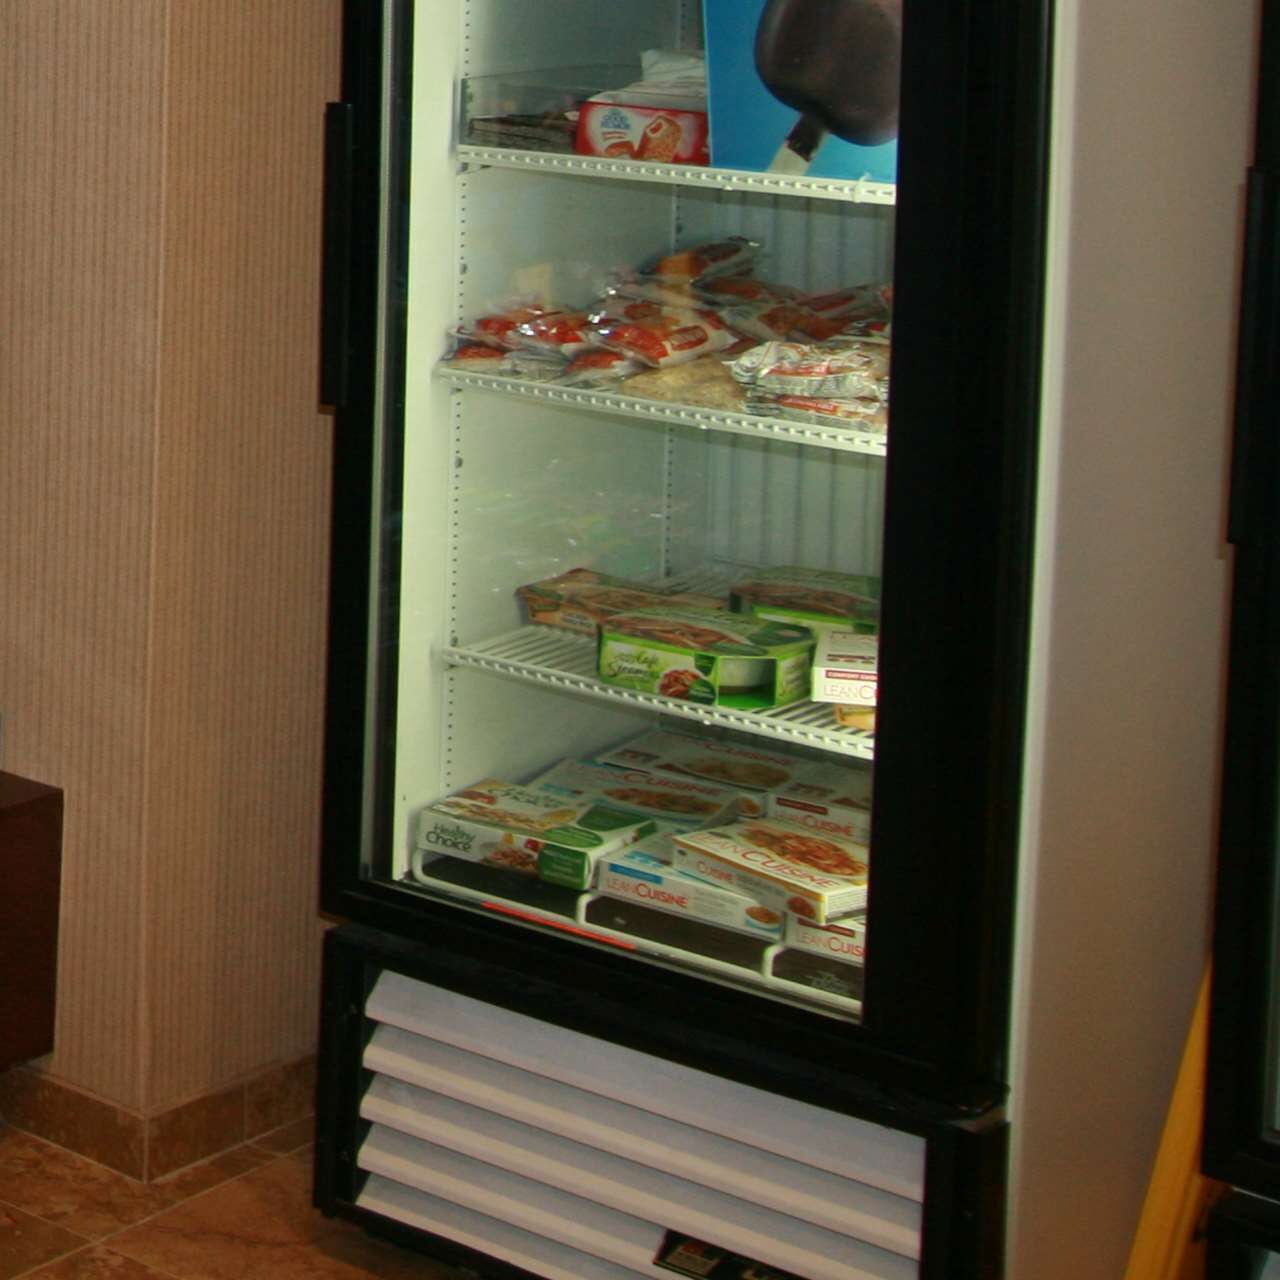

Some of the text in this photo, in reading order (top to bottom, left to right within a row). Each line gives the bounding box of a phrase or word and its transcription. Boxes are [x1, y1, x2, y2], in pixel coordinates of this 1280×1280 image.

[425, 831, 473, 852] Choice
[742, 848, 840, 890] CUISINE
[636, 882, 690, 908] CUISINE
[826, 935, 864, 957] CUIS
